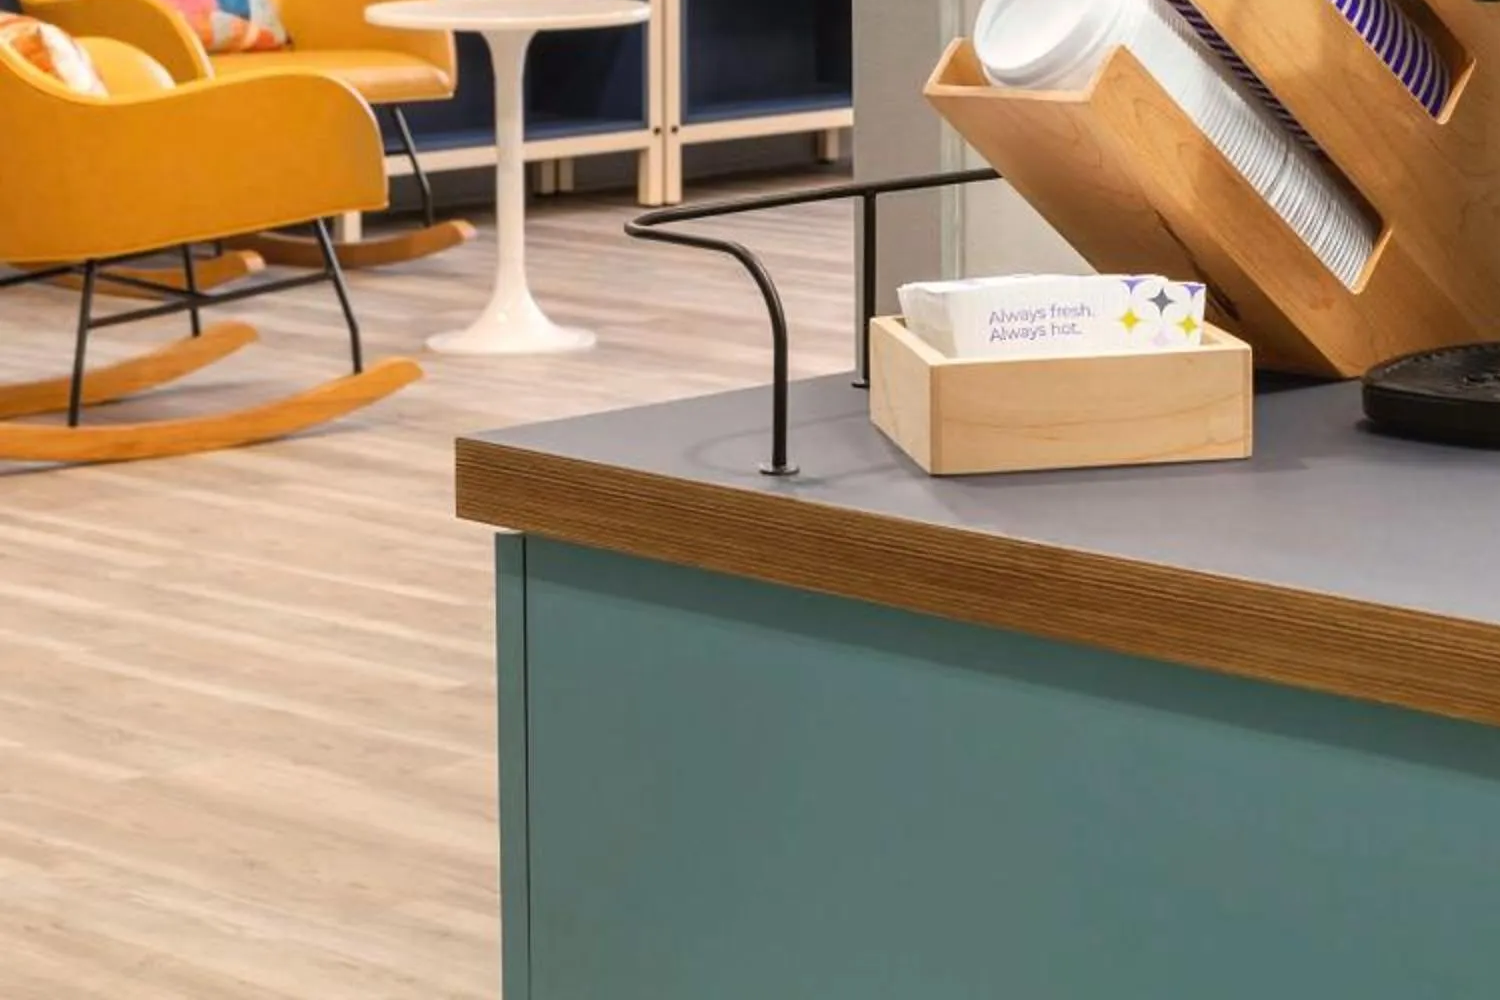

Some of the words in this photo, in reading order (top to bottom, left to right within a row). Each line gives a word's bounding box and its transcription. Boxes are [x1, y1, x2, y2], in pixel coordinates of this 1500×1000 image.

[988, 306, 1047, 326] Always
[1050, 302, 1096, 319] fresh.
[988, 325, 1047, 342] Always
[1051, 322, 1083, 337] hot.
